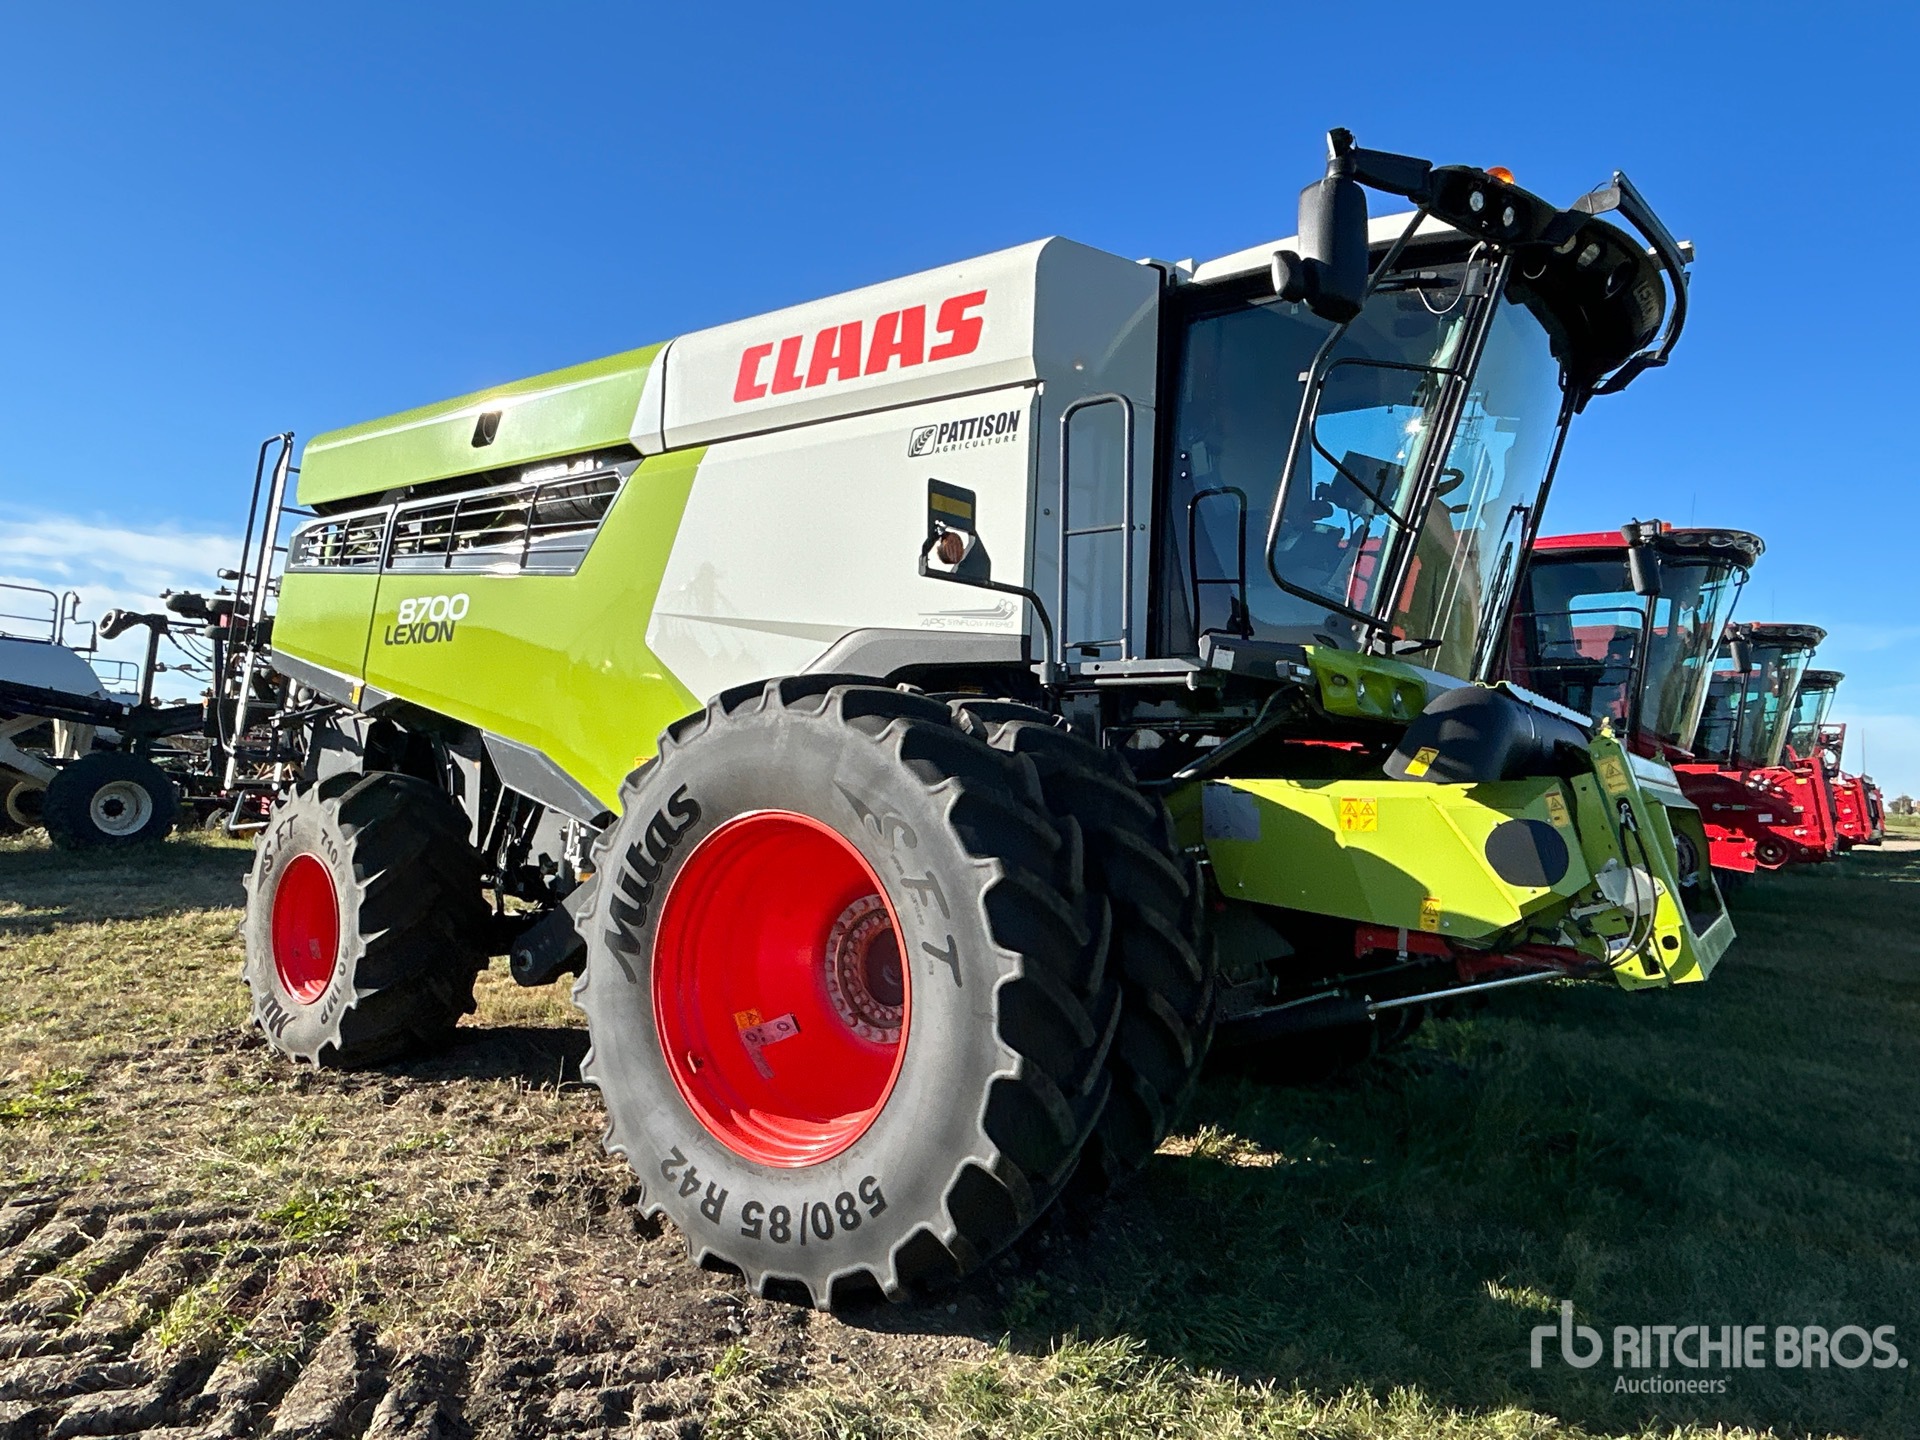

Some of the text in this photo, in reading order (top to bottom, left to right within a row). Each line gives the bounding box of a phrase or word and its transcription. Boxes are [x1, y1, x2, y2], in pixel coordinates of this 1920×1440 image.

[733, 289, 988, 403] CLAAS
[934, 433, 1018, 454] AGRICULTURE
[937, 409, 1021, 445] PATTISON
[398, 593, 470, 625] 8700
[920, 617, 946, 629] APS
[384, 620, 456, 646] LEXION
[604, 783, 702, 984] Mitas
[659, 1145, 888, 1246] 580/85 R42
